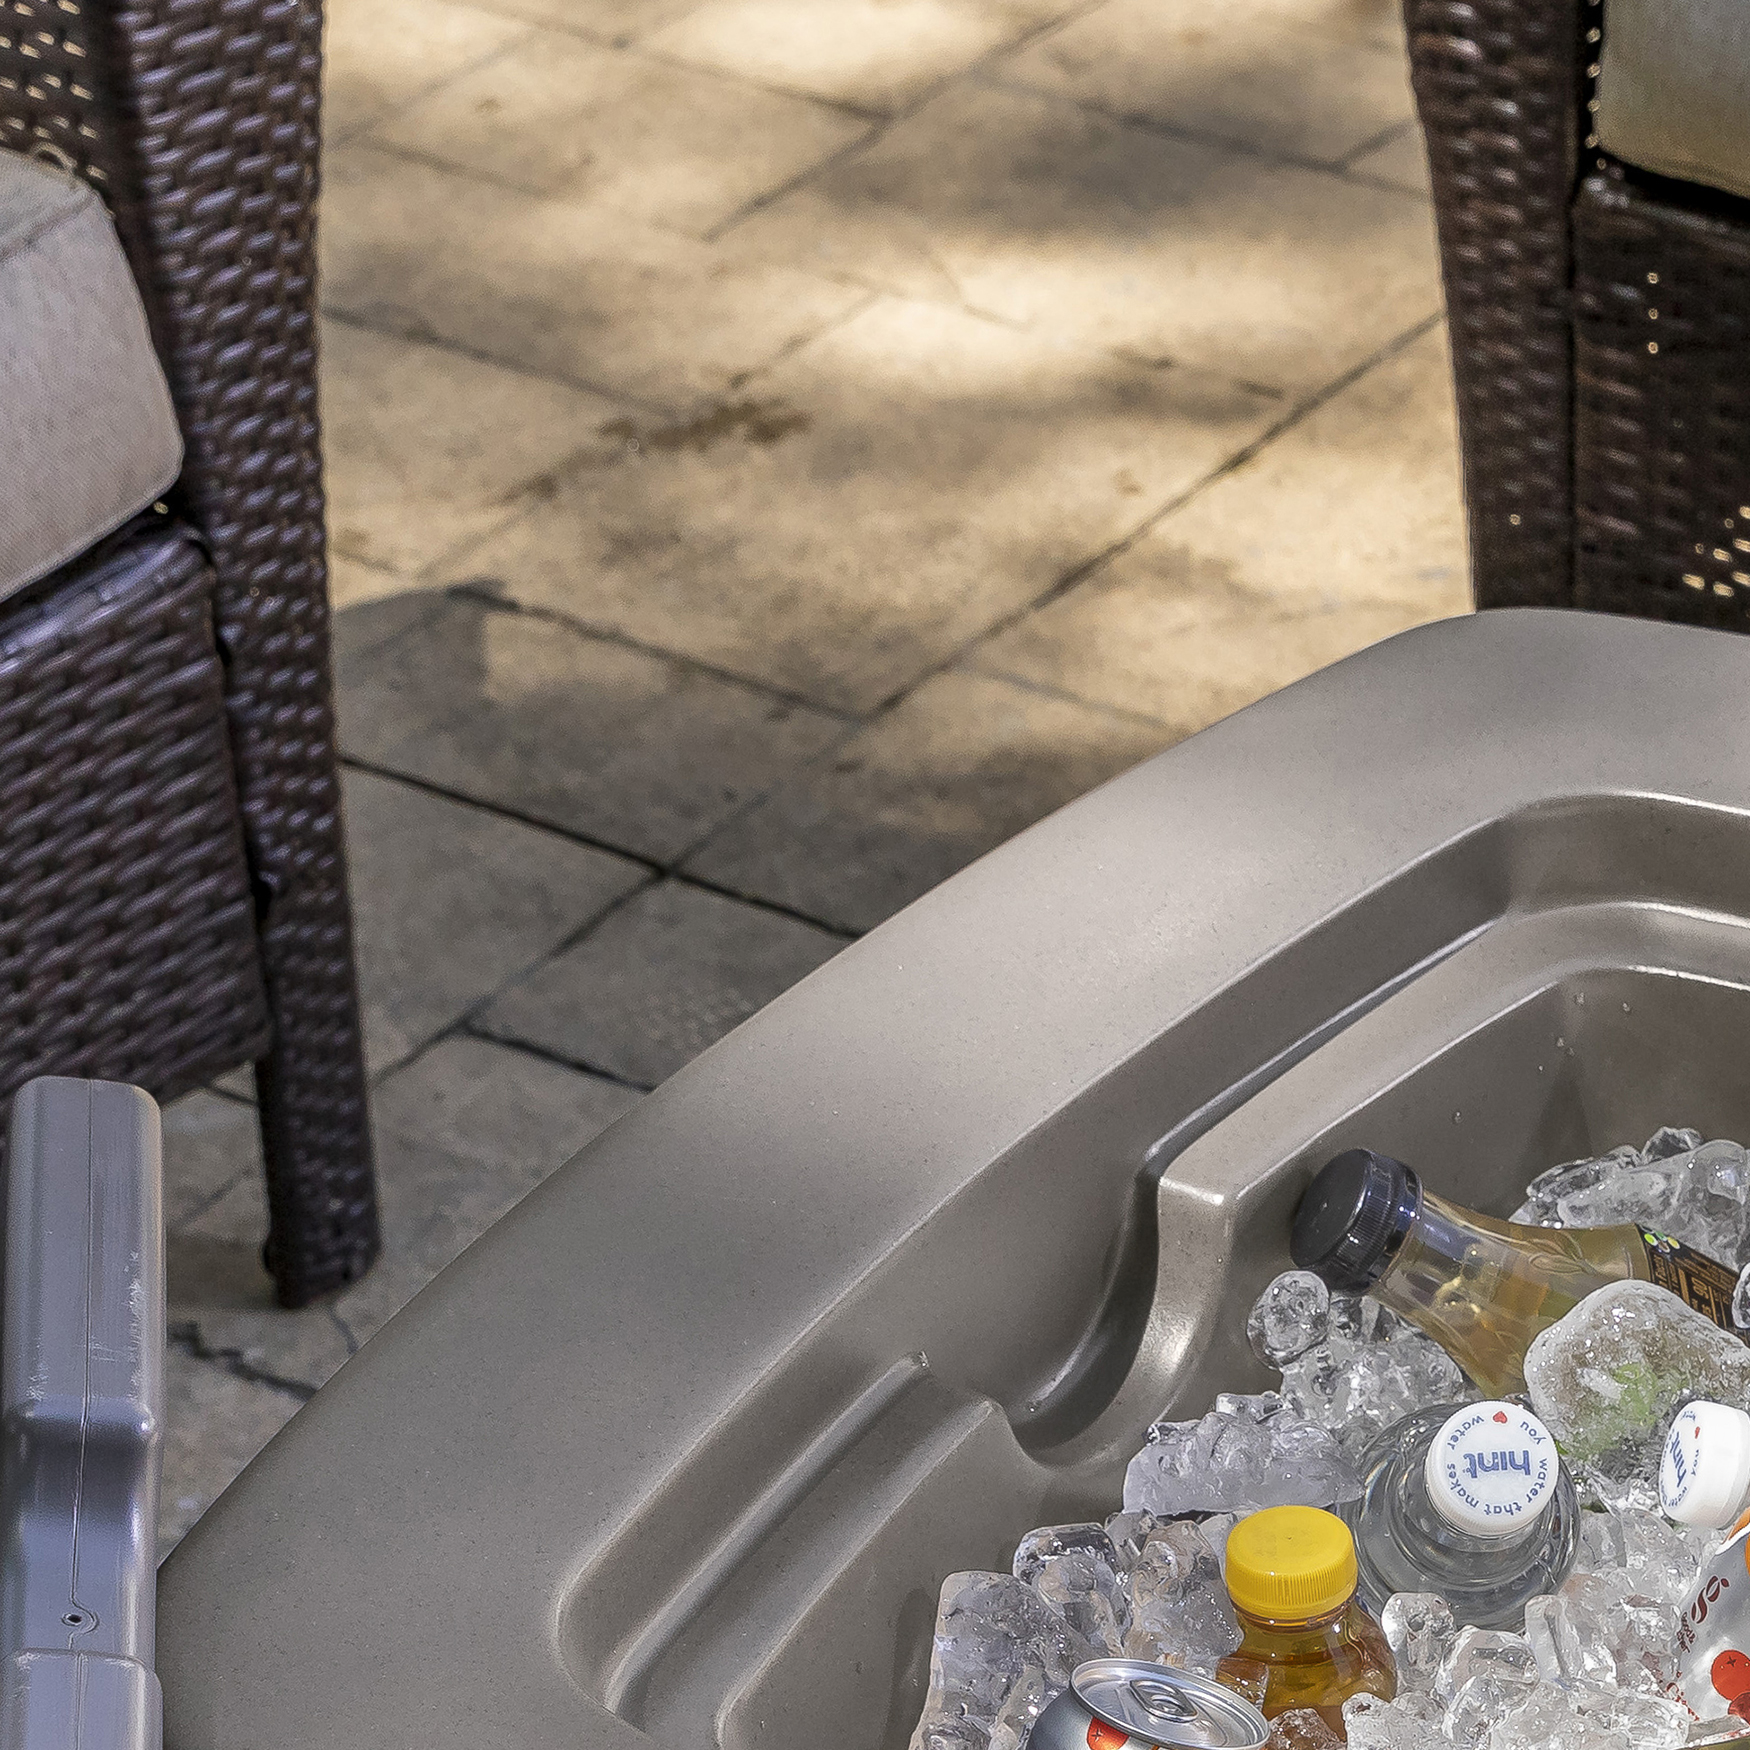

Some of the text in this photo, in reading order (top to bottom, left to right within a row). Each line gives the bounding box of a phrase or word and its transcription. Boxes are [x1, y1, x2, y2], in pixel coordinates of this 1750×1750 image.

[1447, 1415, 1547, 1450] you water
[1462, 1450, 1531, 1478] hint
[1669, 1431, 1687, 1488] hint
[1447, 1458, 1548, 1515] water that makes
